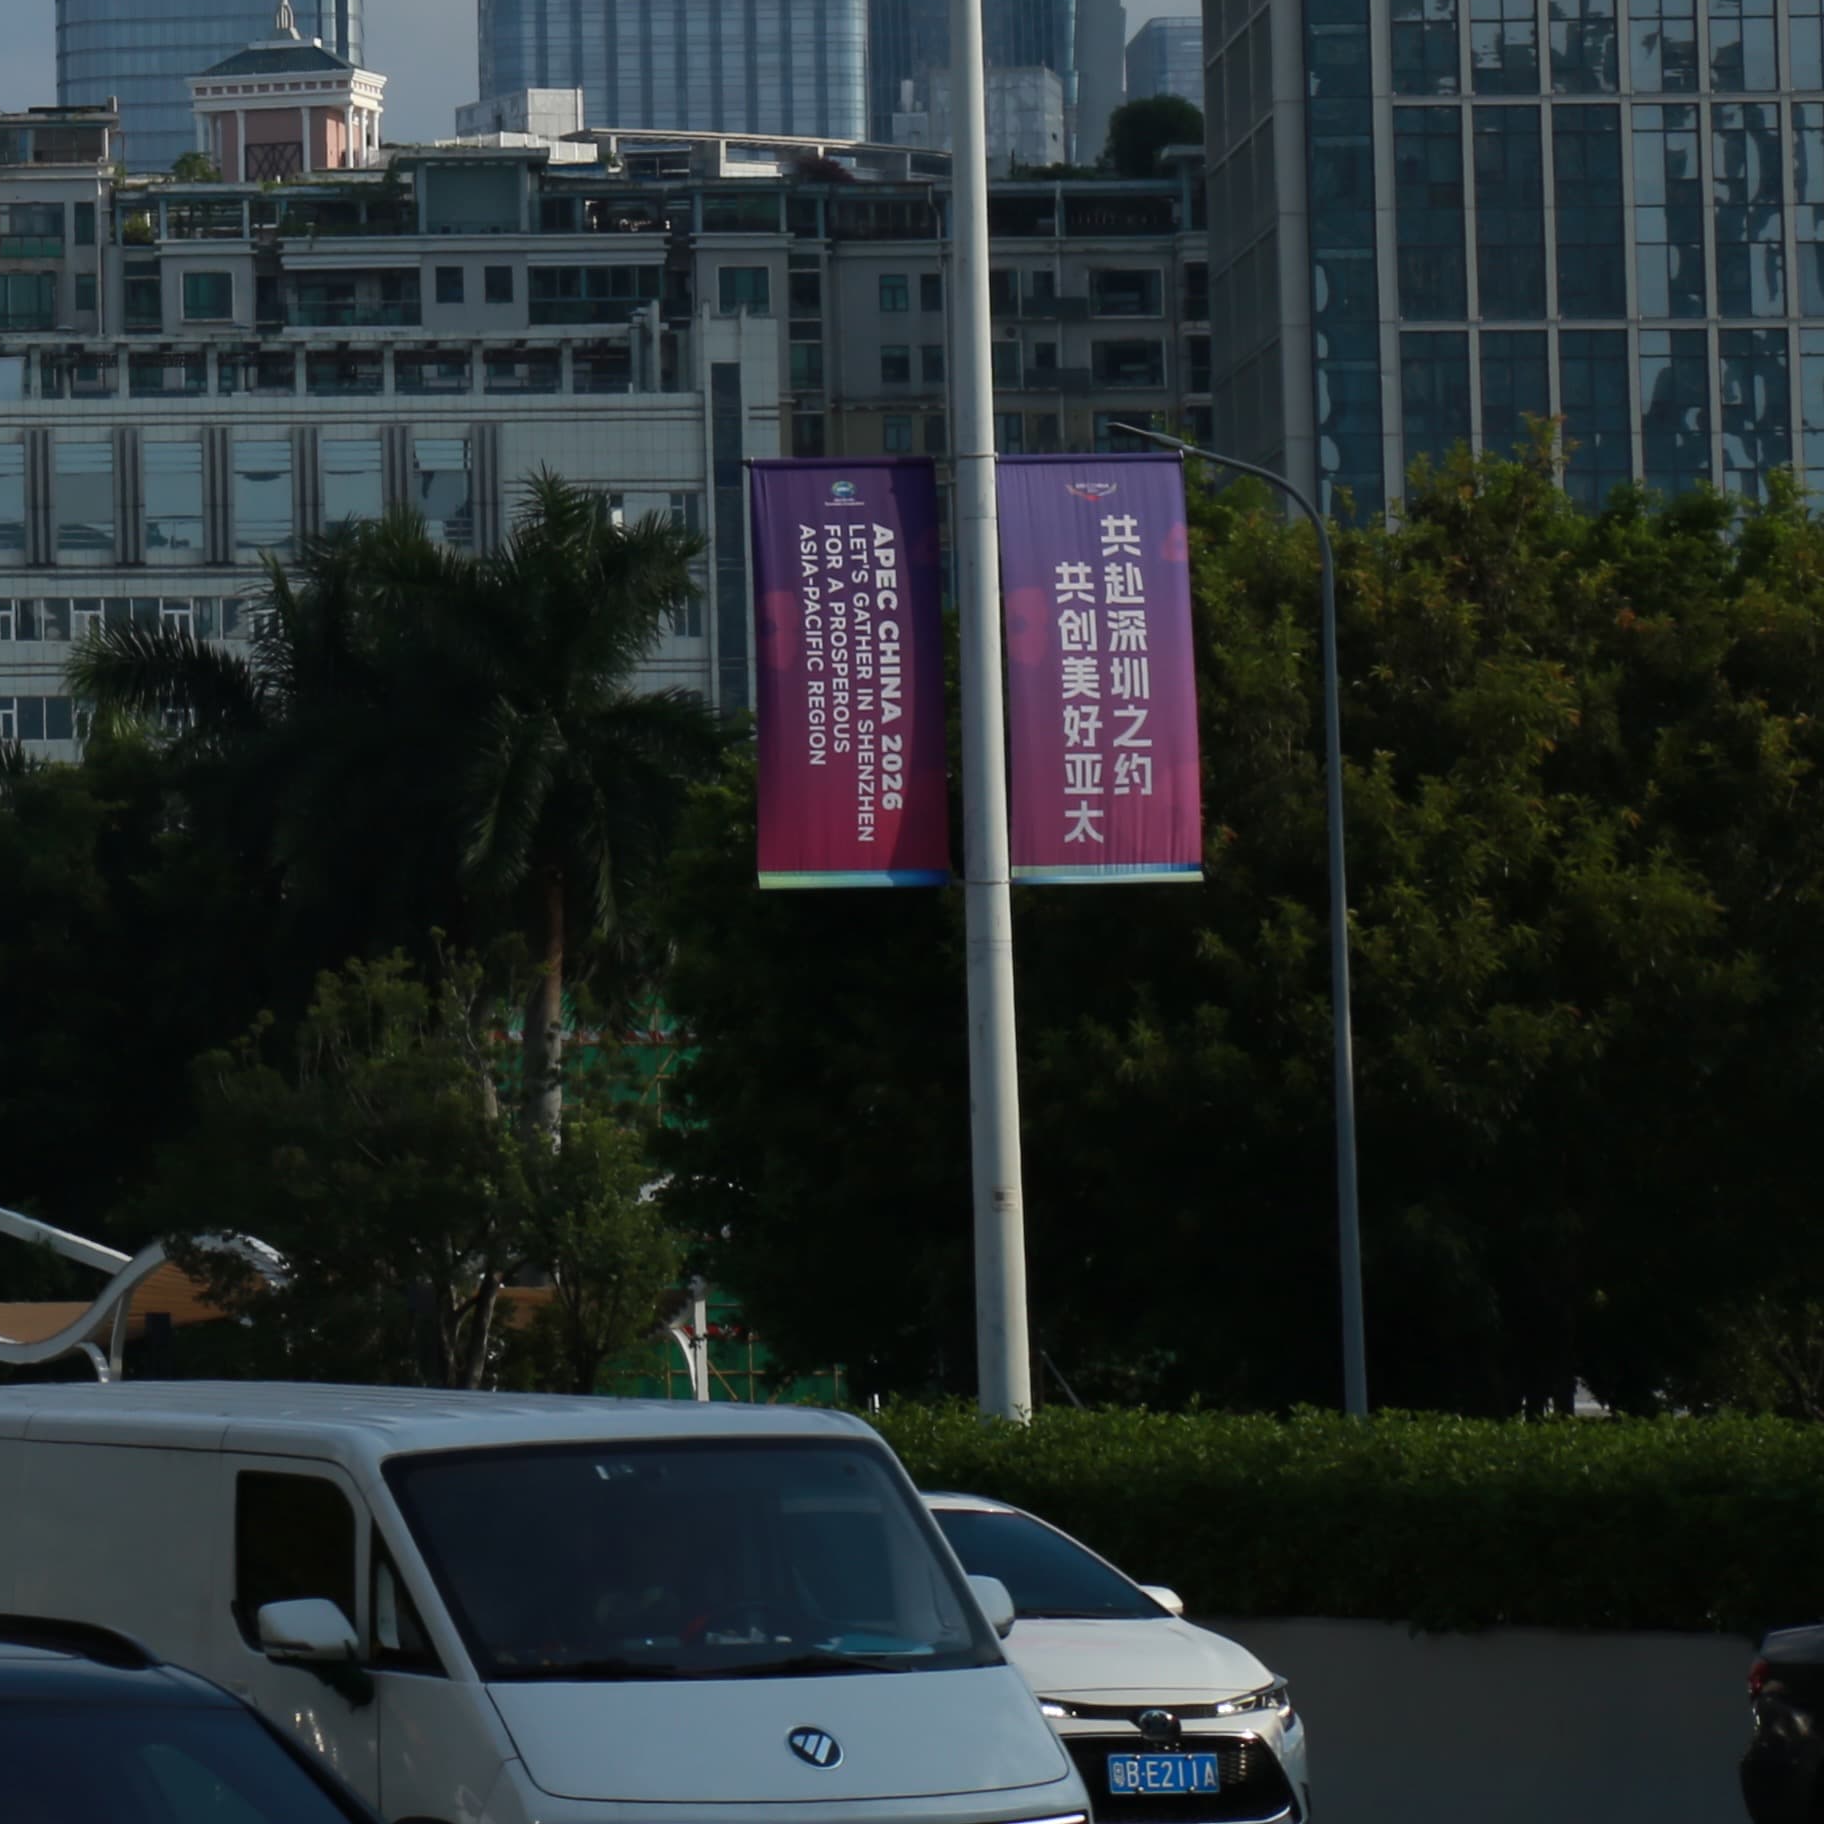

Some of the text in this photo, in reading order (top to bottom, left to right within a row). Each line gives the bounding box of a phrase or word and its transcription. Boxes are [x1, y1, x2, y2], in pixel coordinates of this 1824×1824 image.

[799, 523, 826, 766] ASIA-PACIFIC REGION
[824, 523, 850, 754] FOR A PROSPEROUS
[848, 523, 875, 843] LET'S GATHER IN SHENZHEN
[872, 523, 904, 812] APEC CHINA 2026
[1055, 561, 1104, 844] 共创美好亚太
[1100, 513, 1152, 797] 共赴深圳之约
